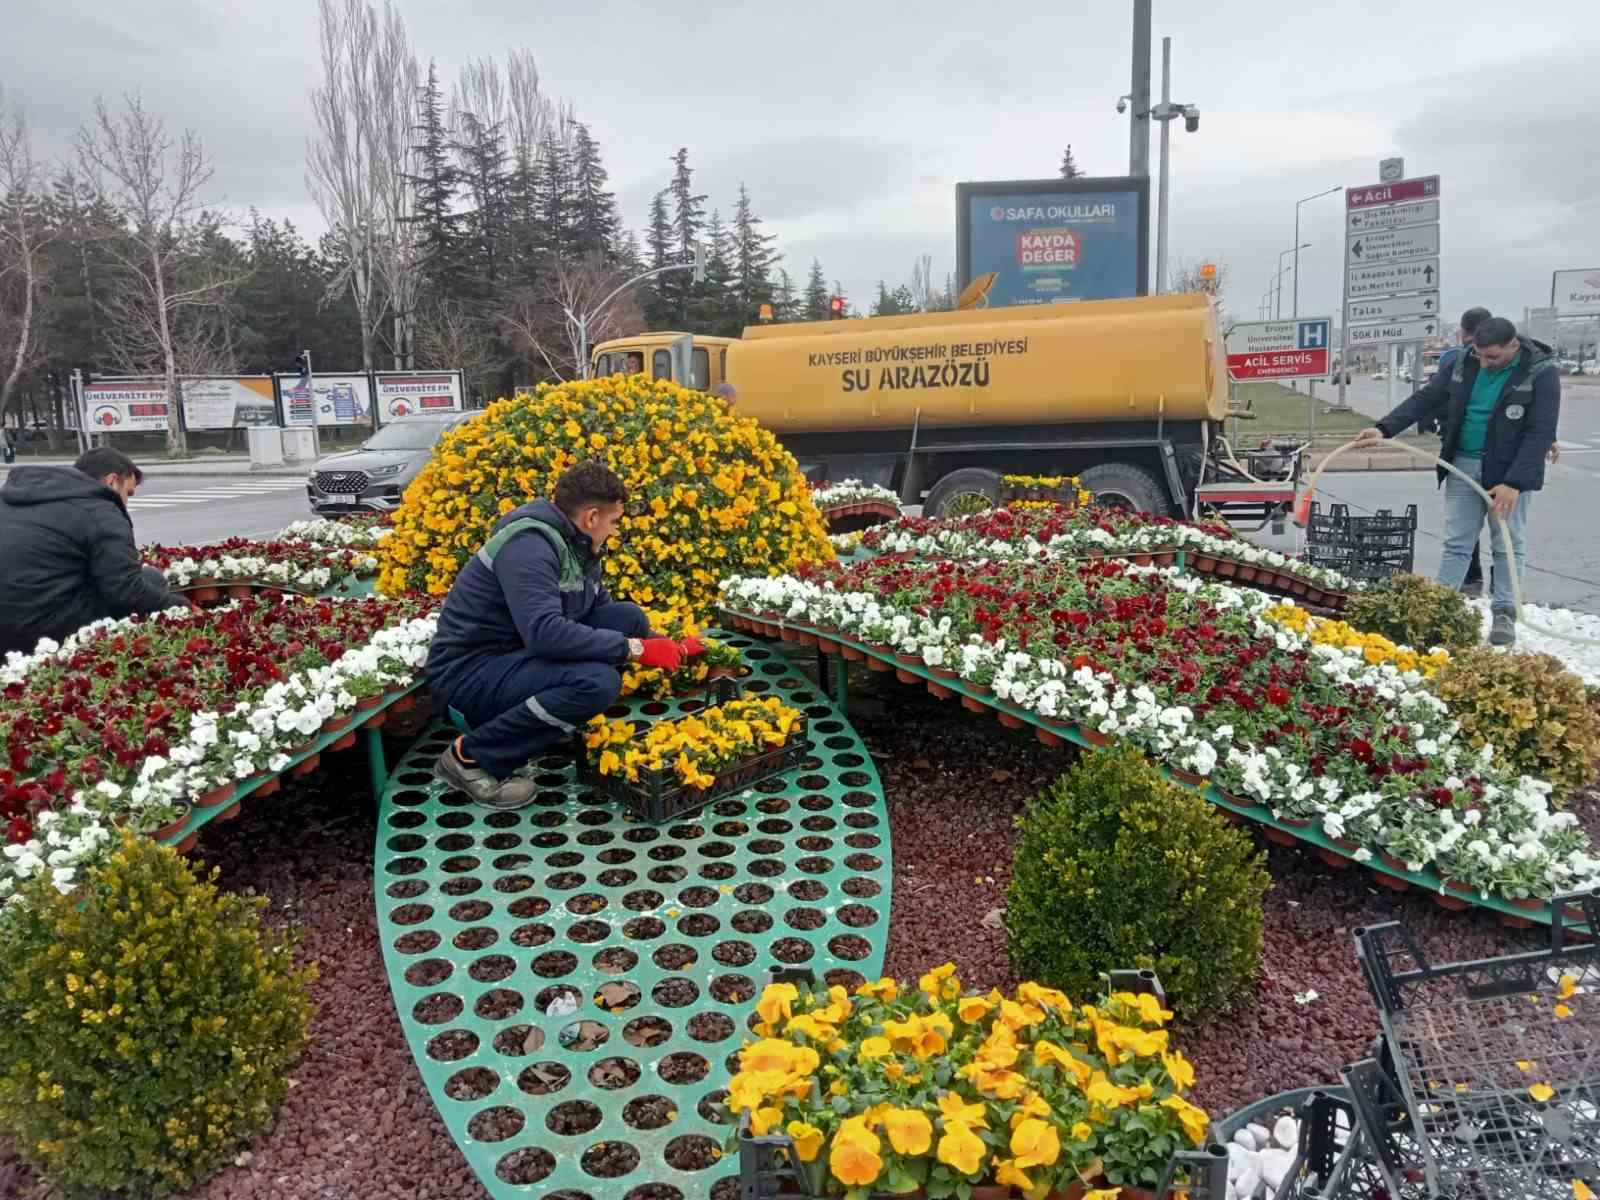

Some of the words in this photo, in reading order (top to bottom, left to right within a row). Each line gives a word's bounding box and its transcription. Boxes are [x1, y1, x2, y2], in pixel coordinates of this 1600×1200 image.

[1364, 187, 1393, 202] Acil
[1006, 207, 1045, 221] SAFA
[1021, 234, 1075, 249] KAYDA
[1022, 248, 1075, 263] DEĞER
[1352, 306, 1382, 316] Talas
[1303, 324, 1322, 346] H
[808, 348, 861, 367] KAYSERİ
[865, 343, 947, 364] BÜYÜKŞEHİR
[951, 337, 1029, 358] BELEDİYESİ
[1244, 356, 1270, 367] ACİL
[1272, 352, 1313, 365] SERVİS
[841, 368, 871, 392] SU
[878, 357, 990, 390] ARAZÖZÜ
